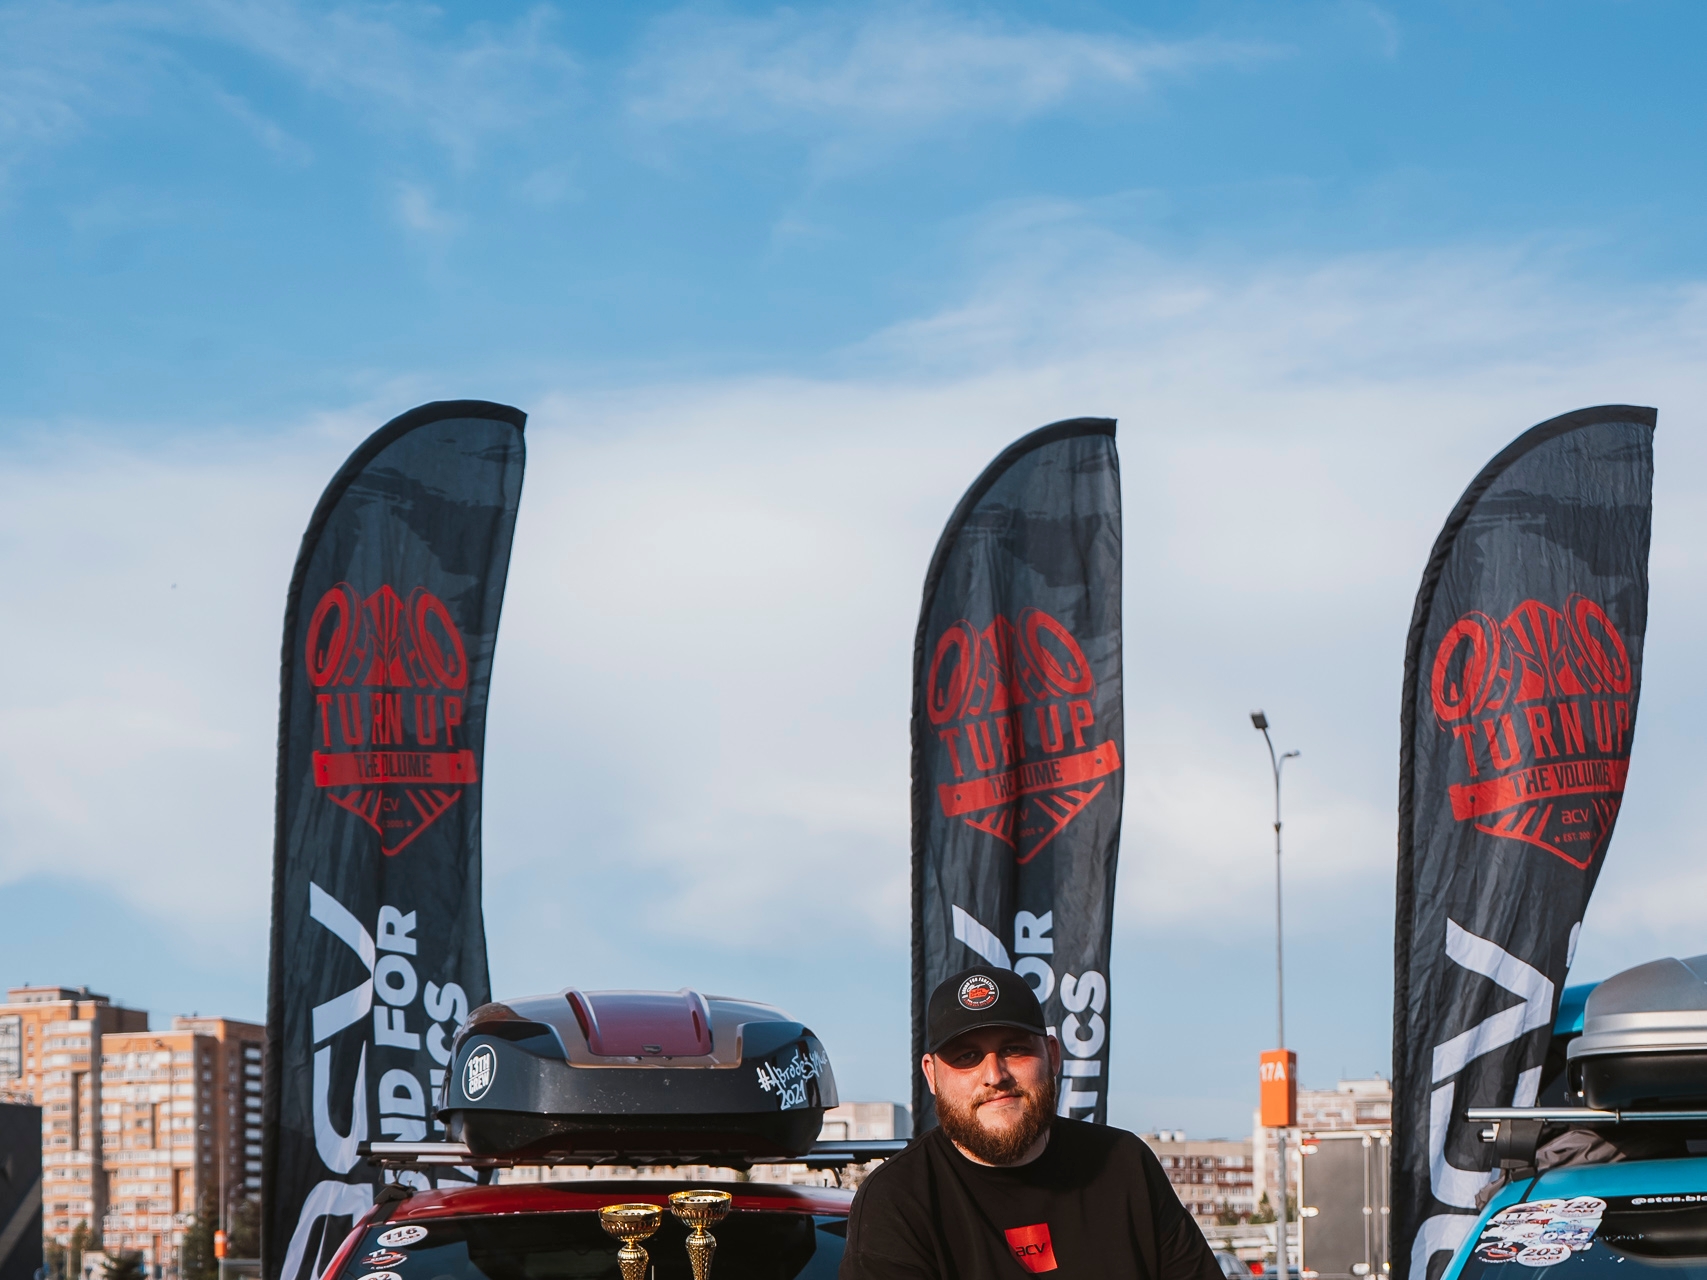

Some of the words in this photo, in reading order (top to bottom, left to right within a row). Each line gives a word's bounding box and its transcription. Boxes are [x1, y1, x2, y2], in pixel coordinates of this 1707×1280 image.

[316, 692, 404, 747] TURN
[414, 695, 463, 746] UP
[1035, 700, 1095, 754] UP
[1452, 701, 1587, 777] TURN
[1592, 700, 1630, 752] UP
[1508, 770, 1550, 798] THE
[1557, 761, 1609, 790] VOLUME
[1561, 808, 1589, 825] acv
[373, 904, 421, 1051] FOR
[1013, 910, 1056, 1037] OR
[468, 1053, 490, 1079] 13TH
[468, 1071, 490, 1095] CREW
[776, 1080, 807, 1110] 2021
[1564, 1201, 1602, 1209] 120
[383, 1227, 418, 1241] 116
[1015, 1242, 1047, 1258] acv
[1522, 1246, 1564, 1257] 203
